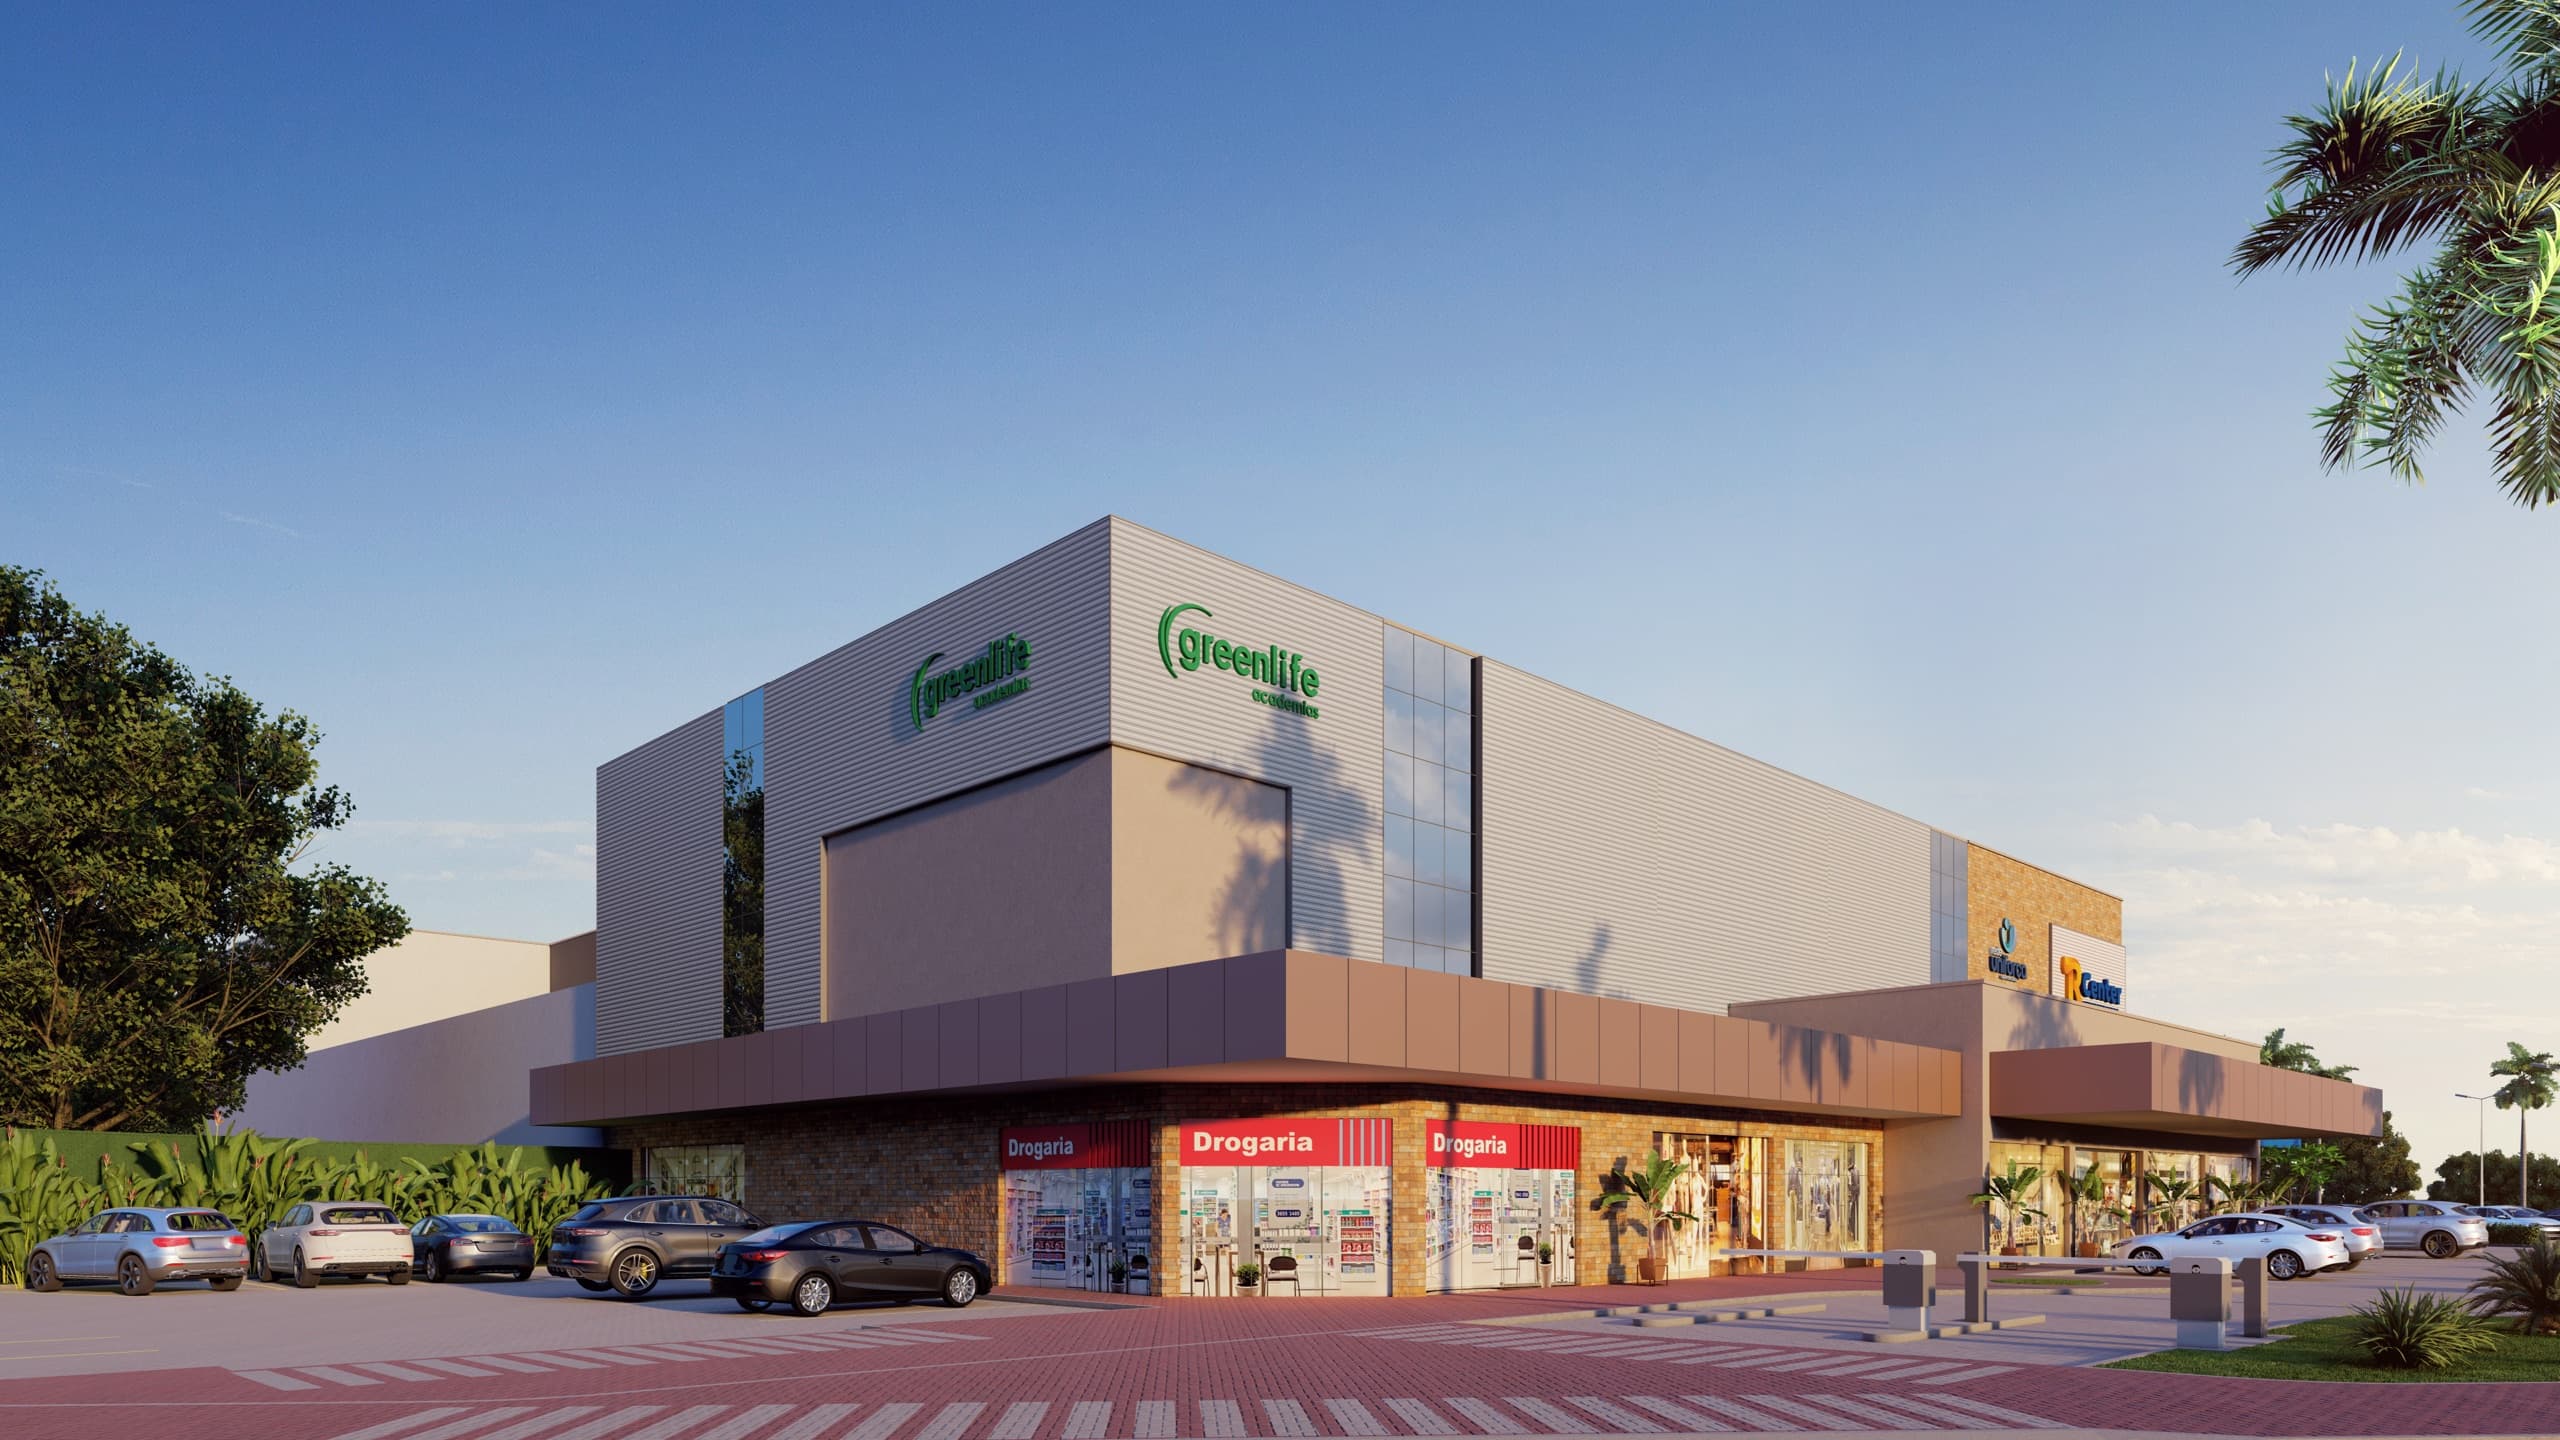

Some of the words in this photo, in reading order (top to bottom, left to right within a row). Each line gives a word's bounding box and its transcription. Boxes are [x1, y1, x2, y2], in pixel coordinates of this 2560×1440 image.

[923, 632, 1031, 718] greenlife
[1178, 628, 1320, 697] greenlife
[1252, 688, 1320, 719] academias
[1008, 1136, 1074, 1160] Drogaria
[1193, 1132, 1313, 1157] Drogaria
[1433, 1132, 1507, 1158] Drogaria
